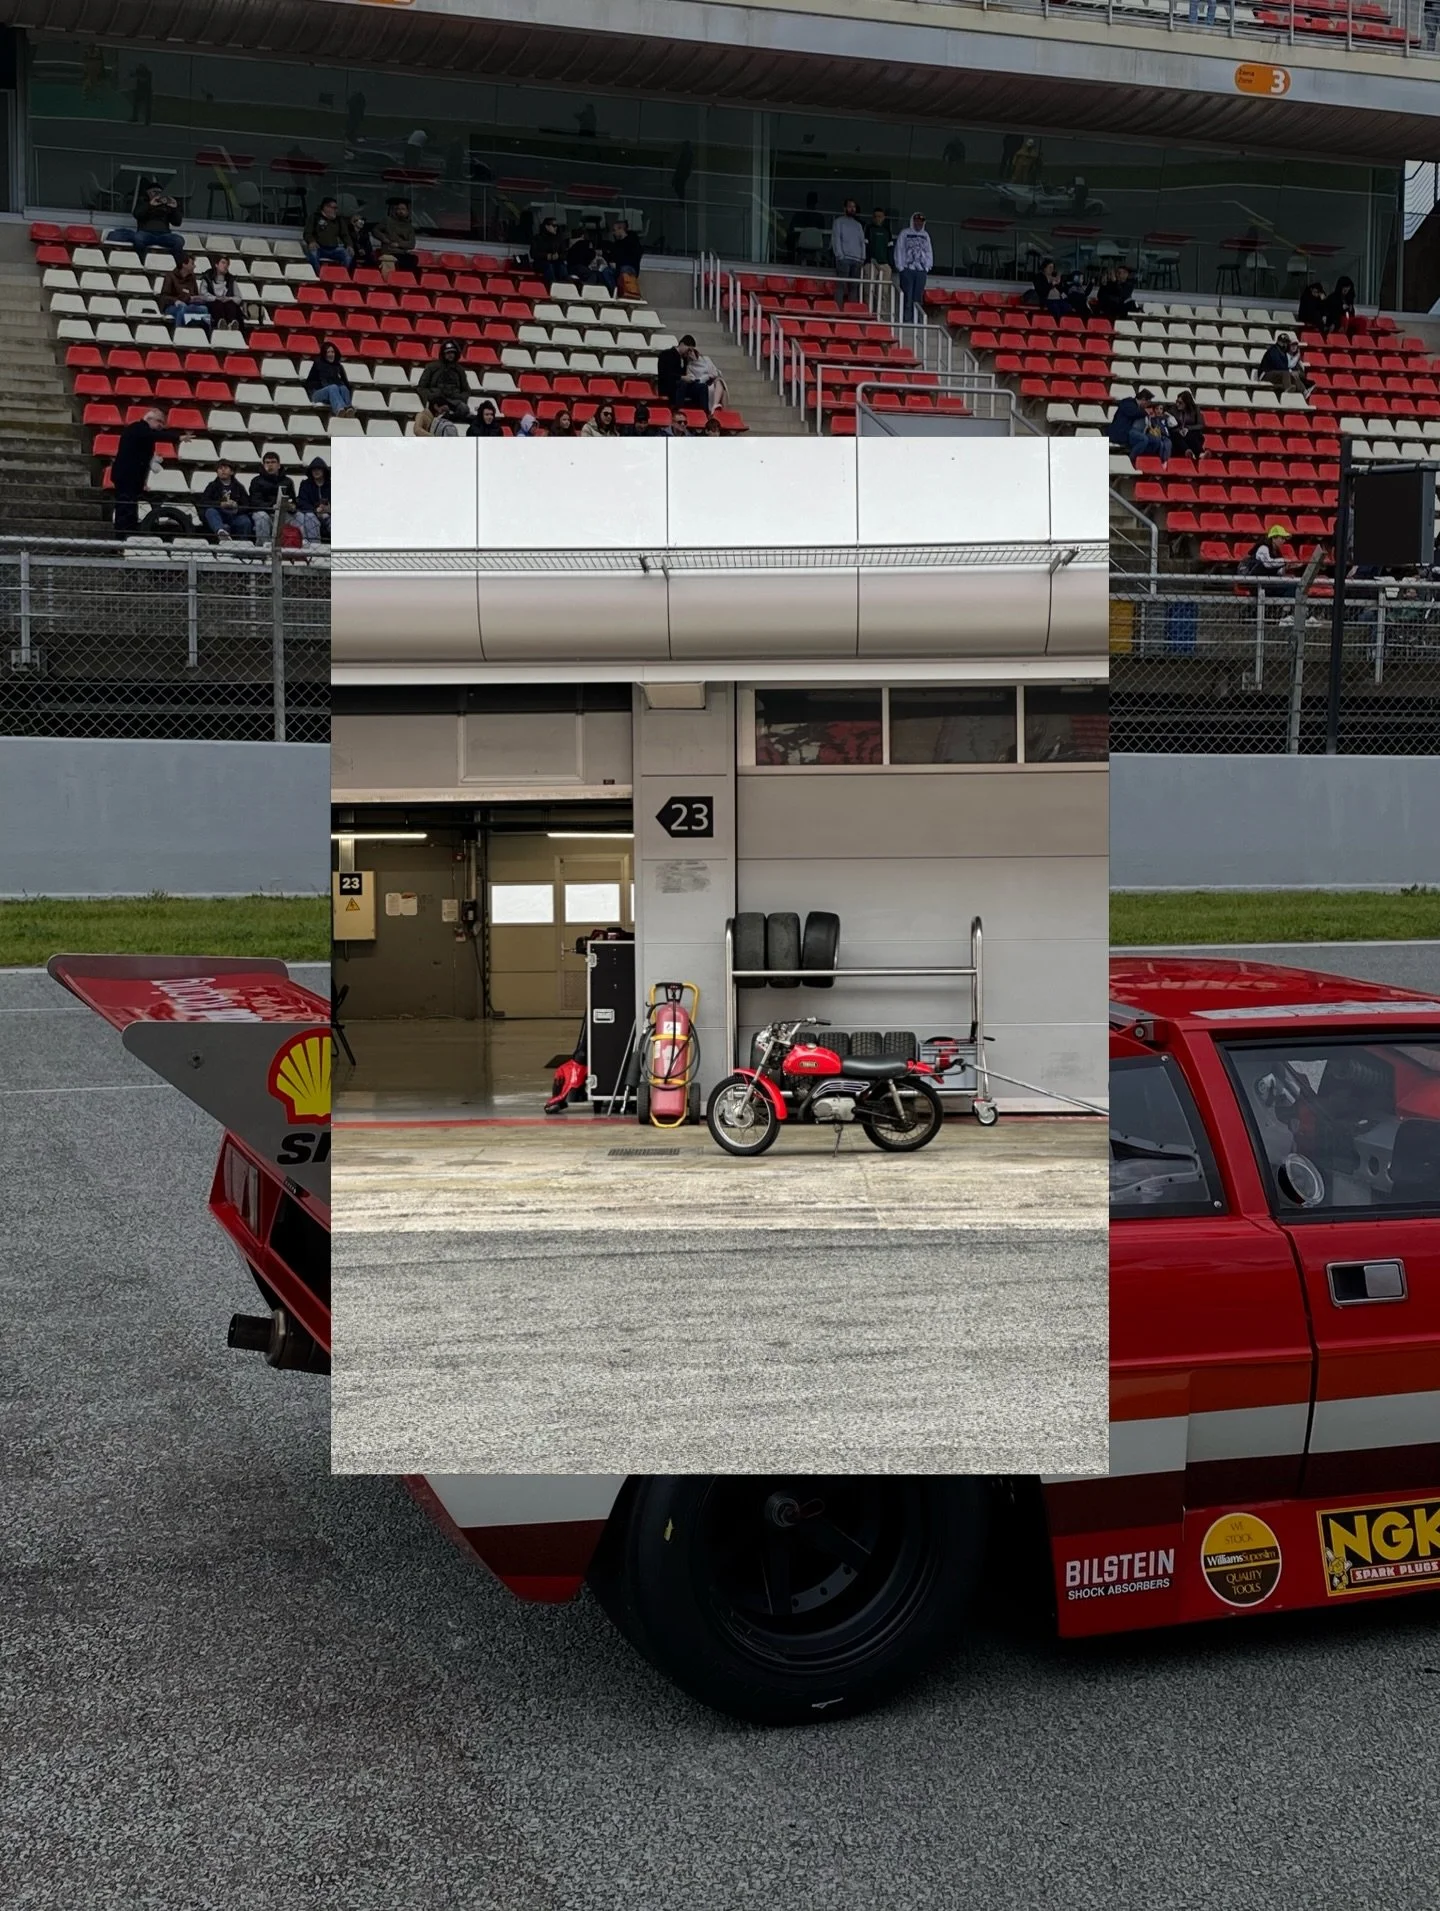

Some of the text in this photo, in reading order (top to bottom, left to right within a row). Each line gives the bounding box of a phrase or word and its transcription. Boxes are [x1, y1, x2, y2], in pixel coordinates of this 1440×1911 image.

[1271, 69, 1285, 93] 3
[671, 803, 709, 831] 23
[342, 877, 360, 889] 23
[1225, 1533, 1254, 1545] STOCK
[1329, 1508, 1440, 1564] NGK
[1066, 1548, 1175, 1587] BILSTEIN
[1226, 1570, 1262, 1585] QUALITY
[1355, 1561, 1439, 1581] SPARK PLUGS
[1068, 1578, 1170, 1600] SHOCK ABSORBERS
[1232, 1583, 1261, 1595] TOOLS
